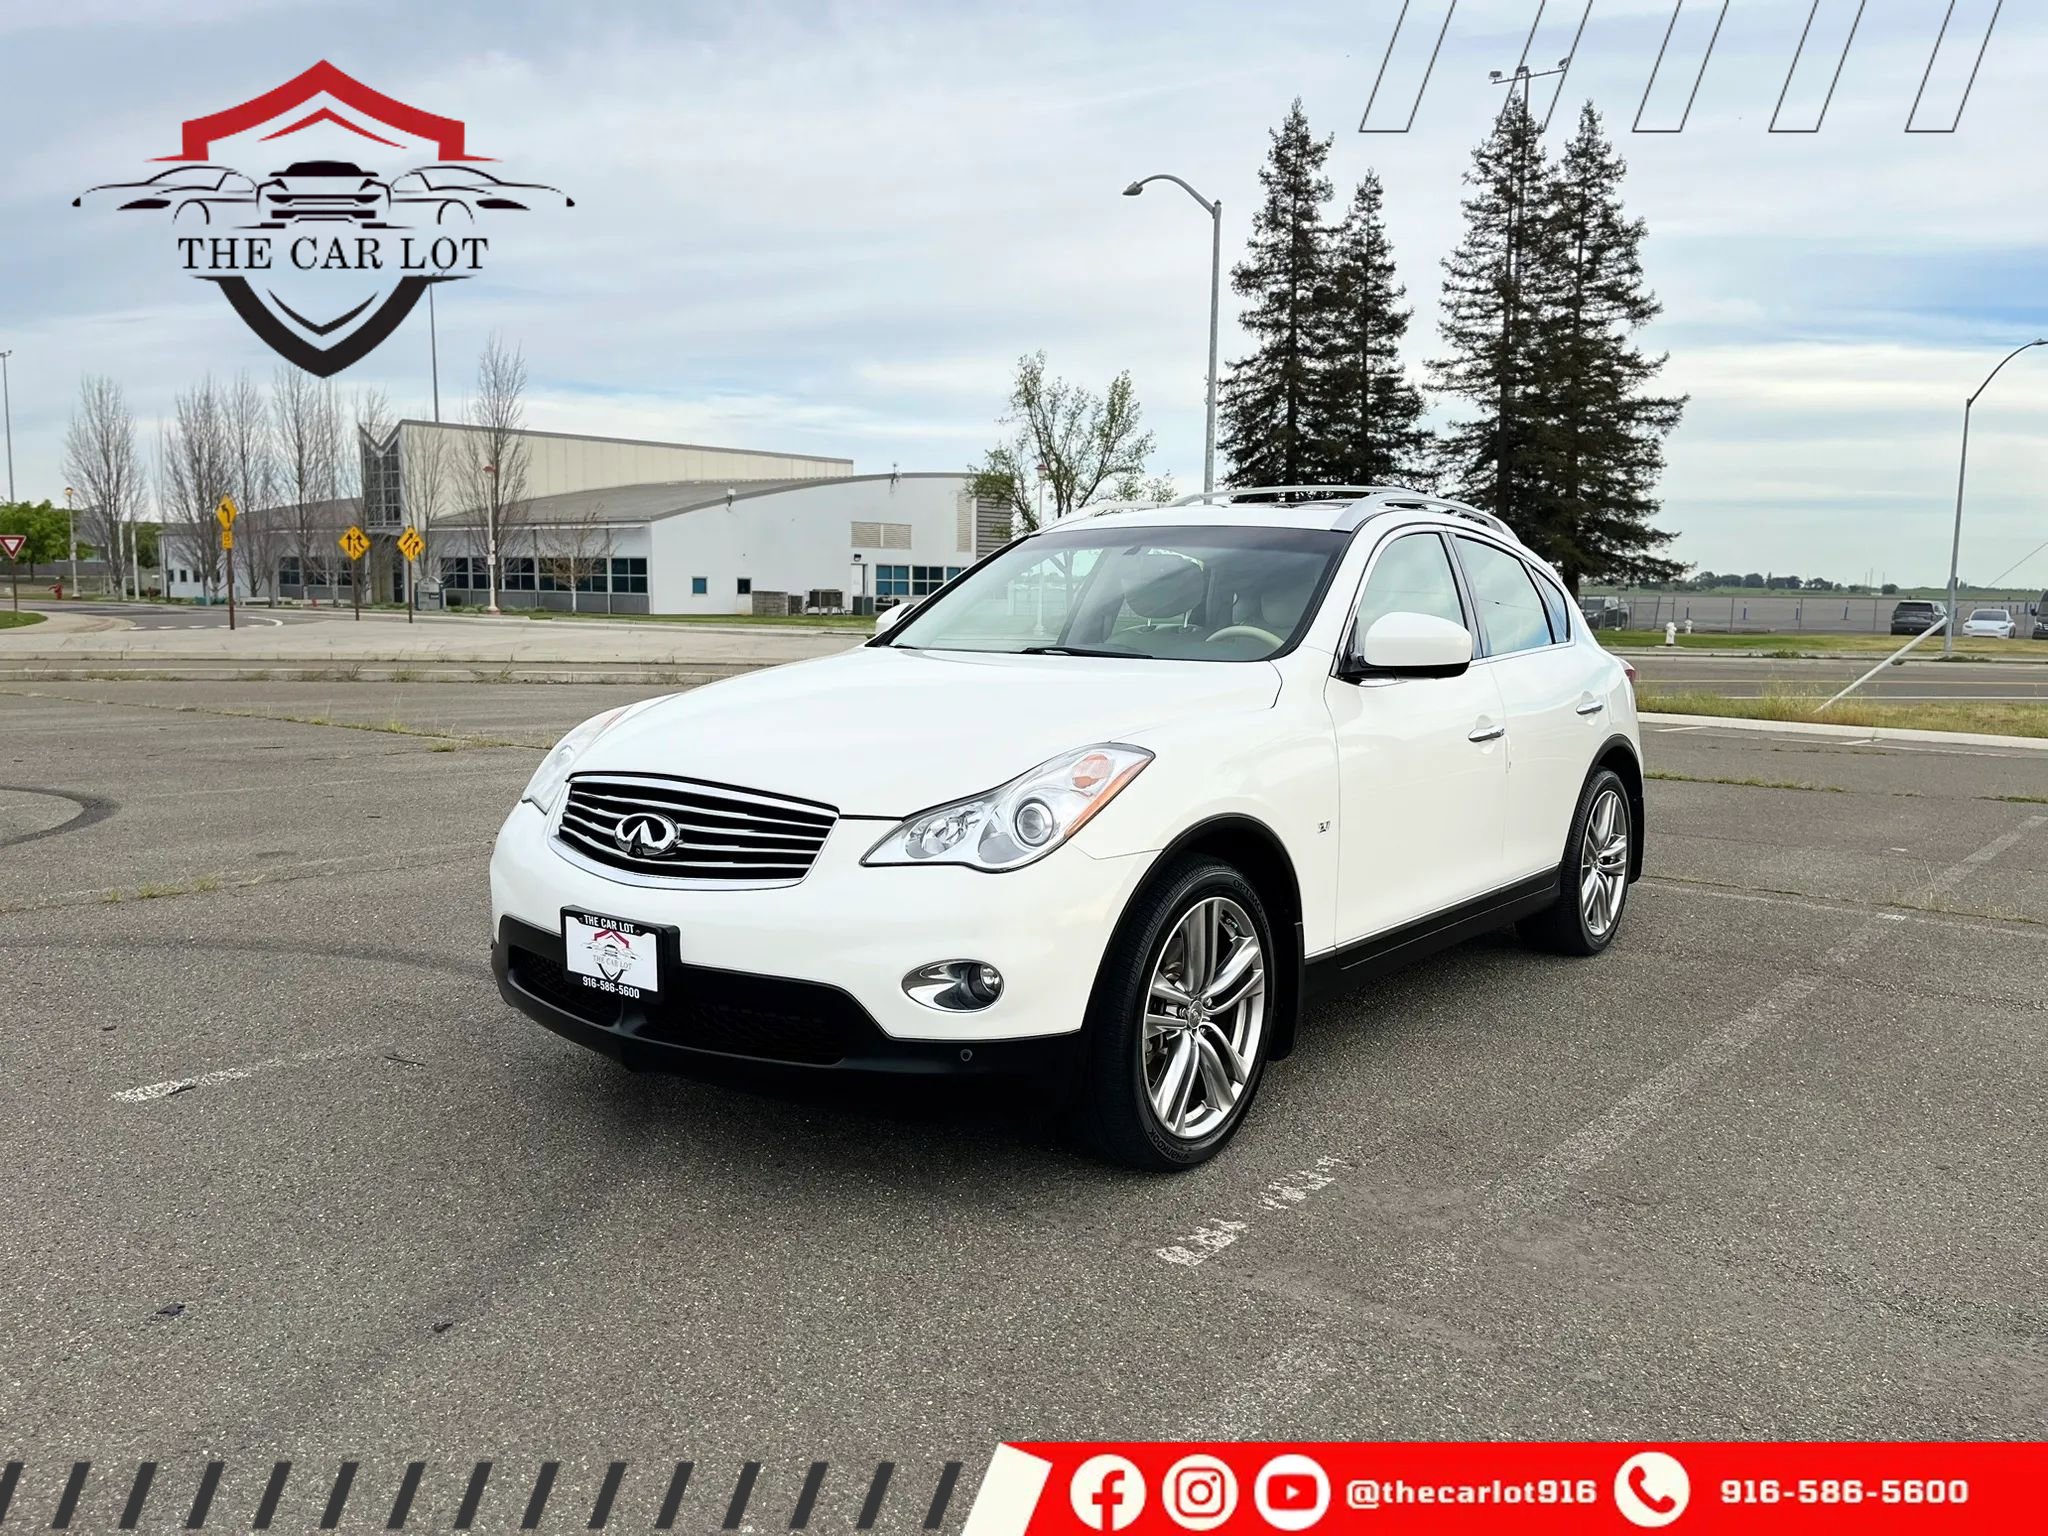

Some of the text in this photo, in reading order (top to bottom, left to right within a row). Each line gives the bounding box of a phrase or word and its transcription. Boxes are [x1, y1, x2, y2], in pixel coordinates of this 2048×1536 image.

[583, 914, 634, 934] THE CAR LOT
[582, 976, 640, 999] 916-586-5600
